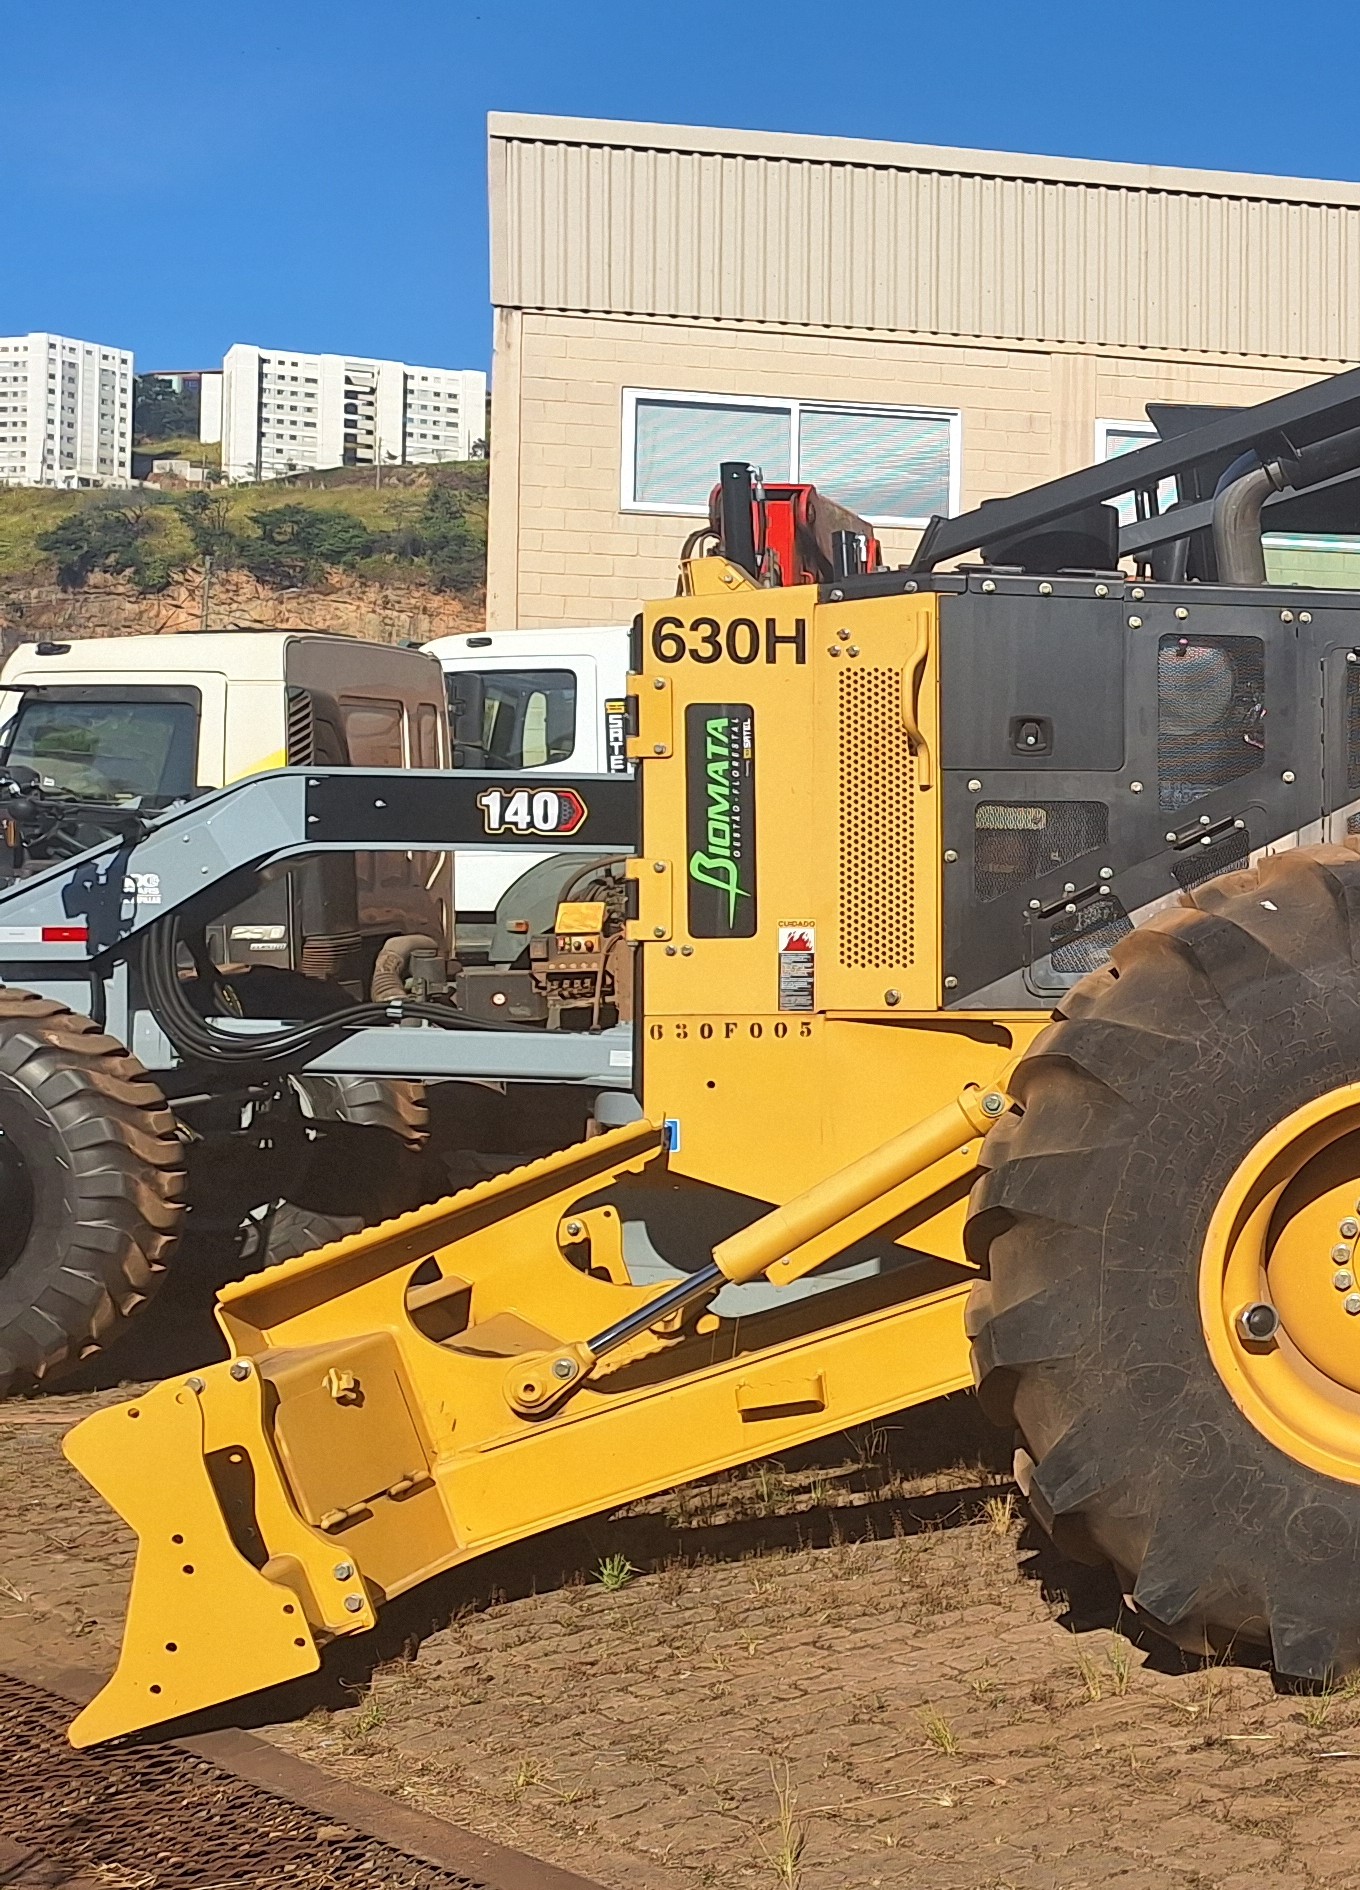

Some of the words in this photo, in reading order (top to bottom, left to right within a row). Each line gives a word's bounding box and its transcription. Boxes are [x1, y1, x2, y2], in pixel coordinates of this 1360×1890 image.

[651, 617, 806, 665] 630H
[481, 791, 559, 830] 140
[690, 716, 751, 930] BIOMATA
[777, 920, 816, 928] CUIDADO
